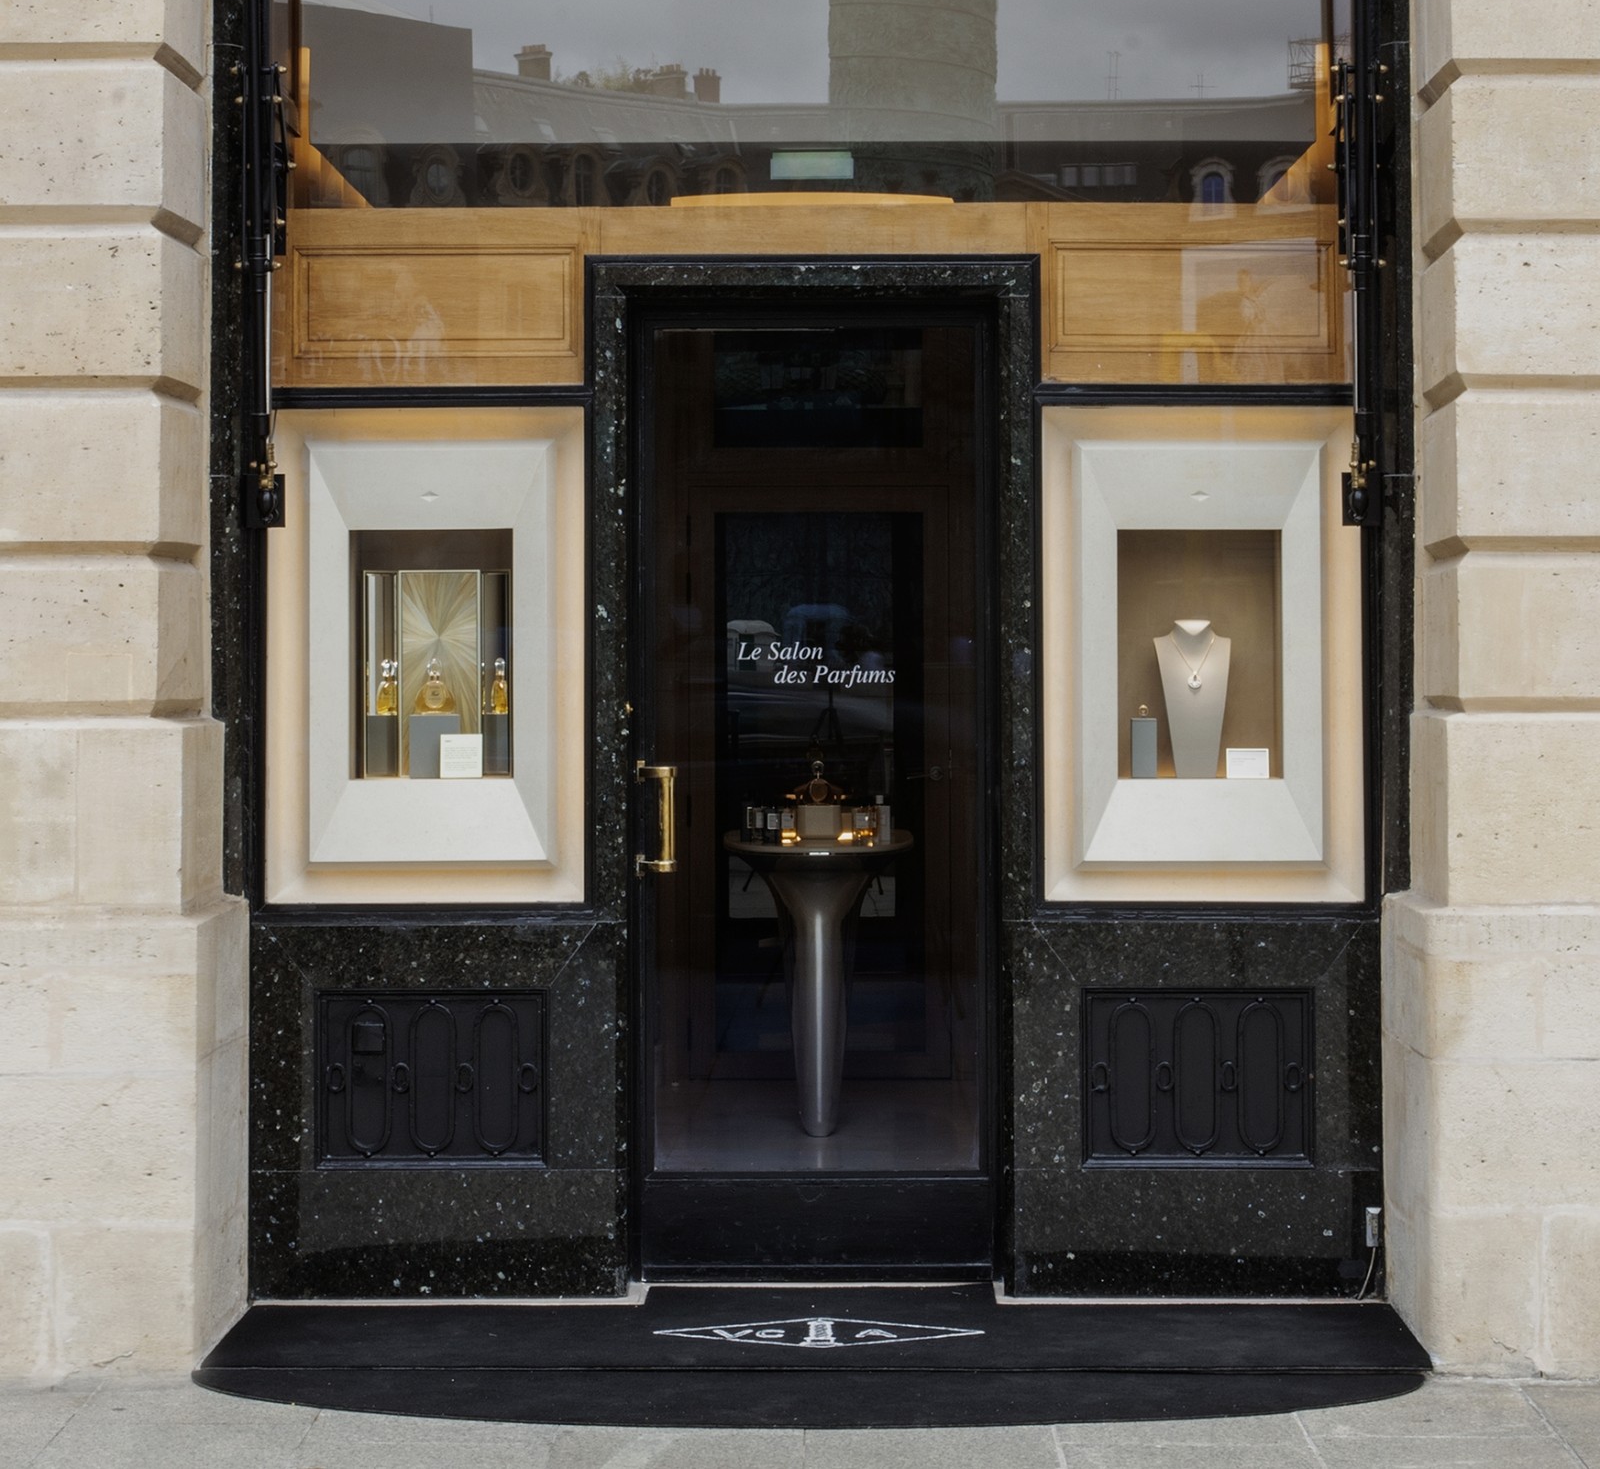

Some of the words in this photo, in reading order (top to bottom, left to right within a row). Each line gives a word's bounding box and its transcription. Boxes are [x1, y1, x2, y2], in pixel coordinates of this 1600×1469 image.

[737, 642, 762, 661] Le
[767, 641, 823, 661] Salon
[773, 665, 808, 684] des
[813, 665, 896, 688] Parfums
